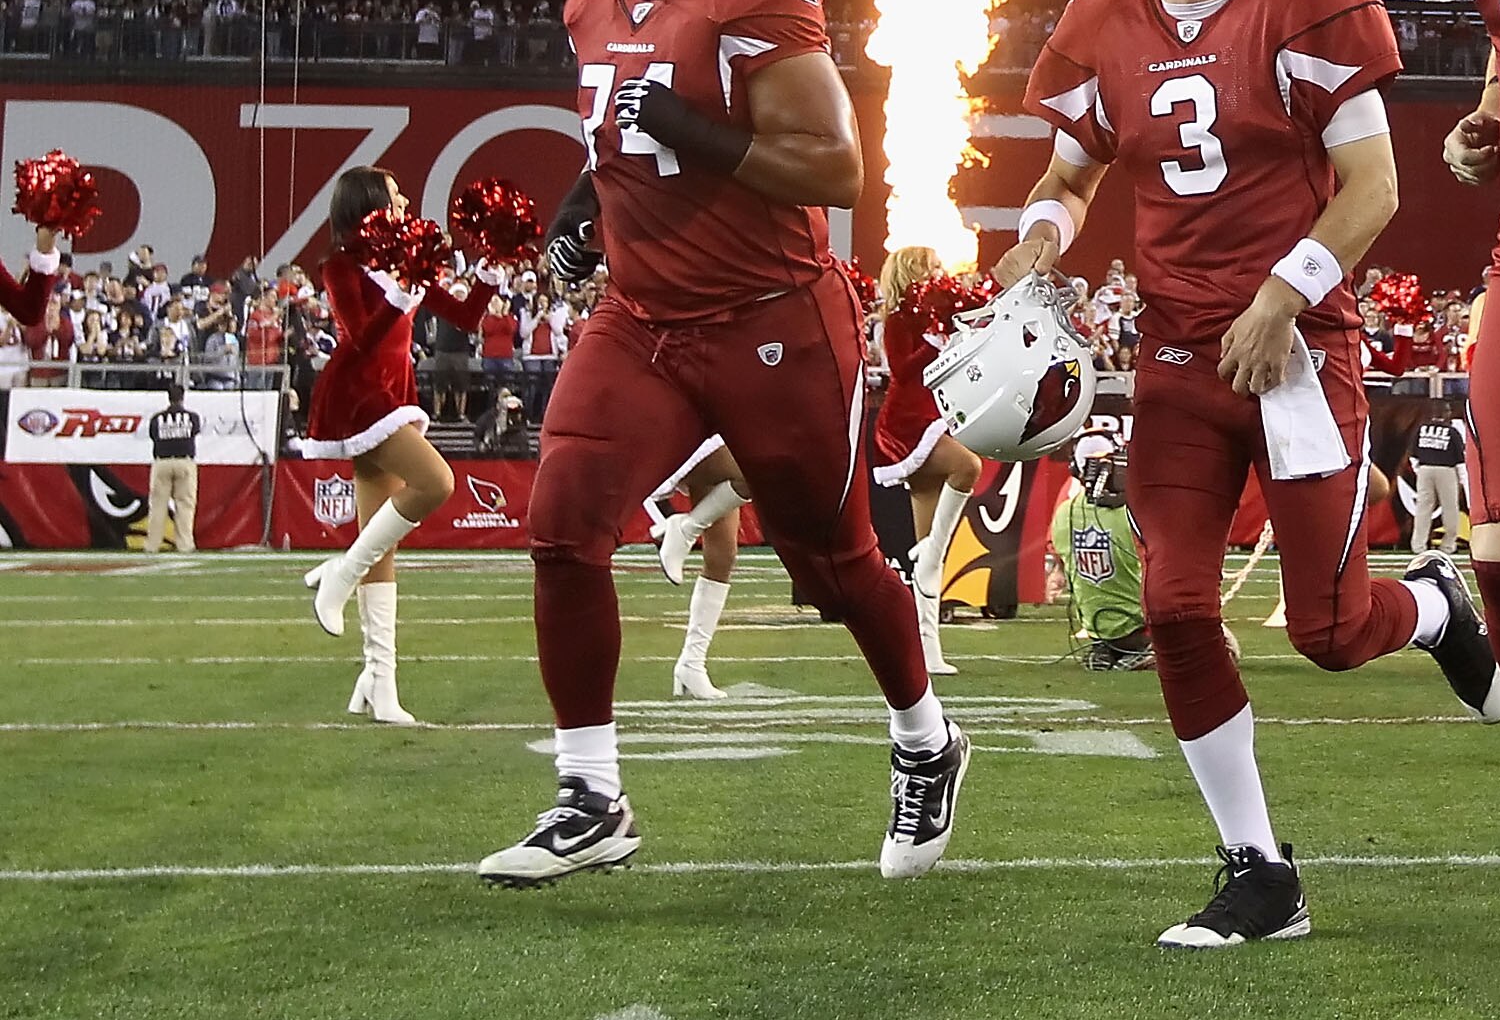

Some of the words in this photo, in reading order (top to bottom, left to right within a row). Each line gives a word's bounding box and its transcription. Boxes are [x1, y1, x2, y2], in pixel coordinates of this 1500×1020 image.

[606, 42, 656, 54] CARDINALS
[1148, 53, 1218, 73] CARDINALS
[1150, 74, 1229, 197] 3
[320, 499, 349, 513] NFL
[453, 518, 520, 529] CARDINALS
[1077, 549, 1112, 574] NFL
